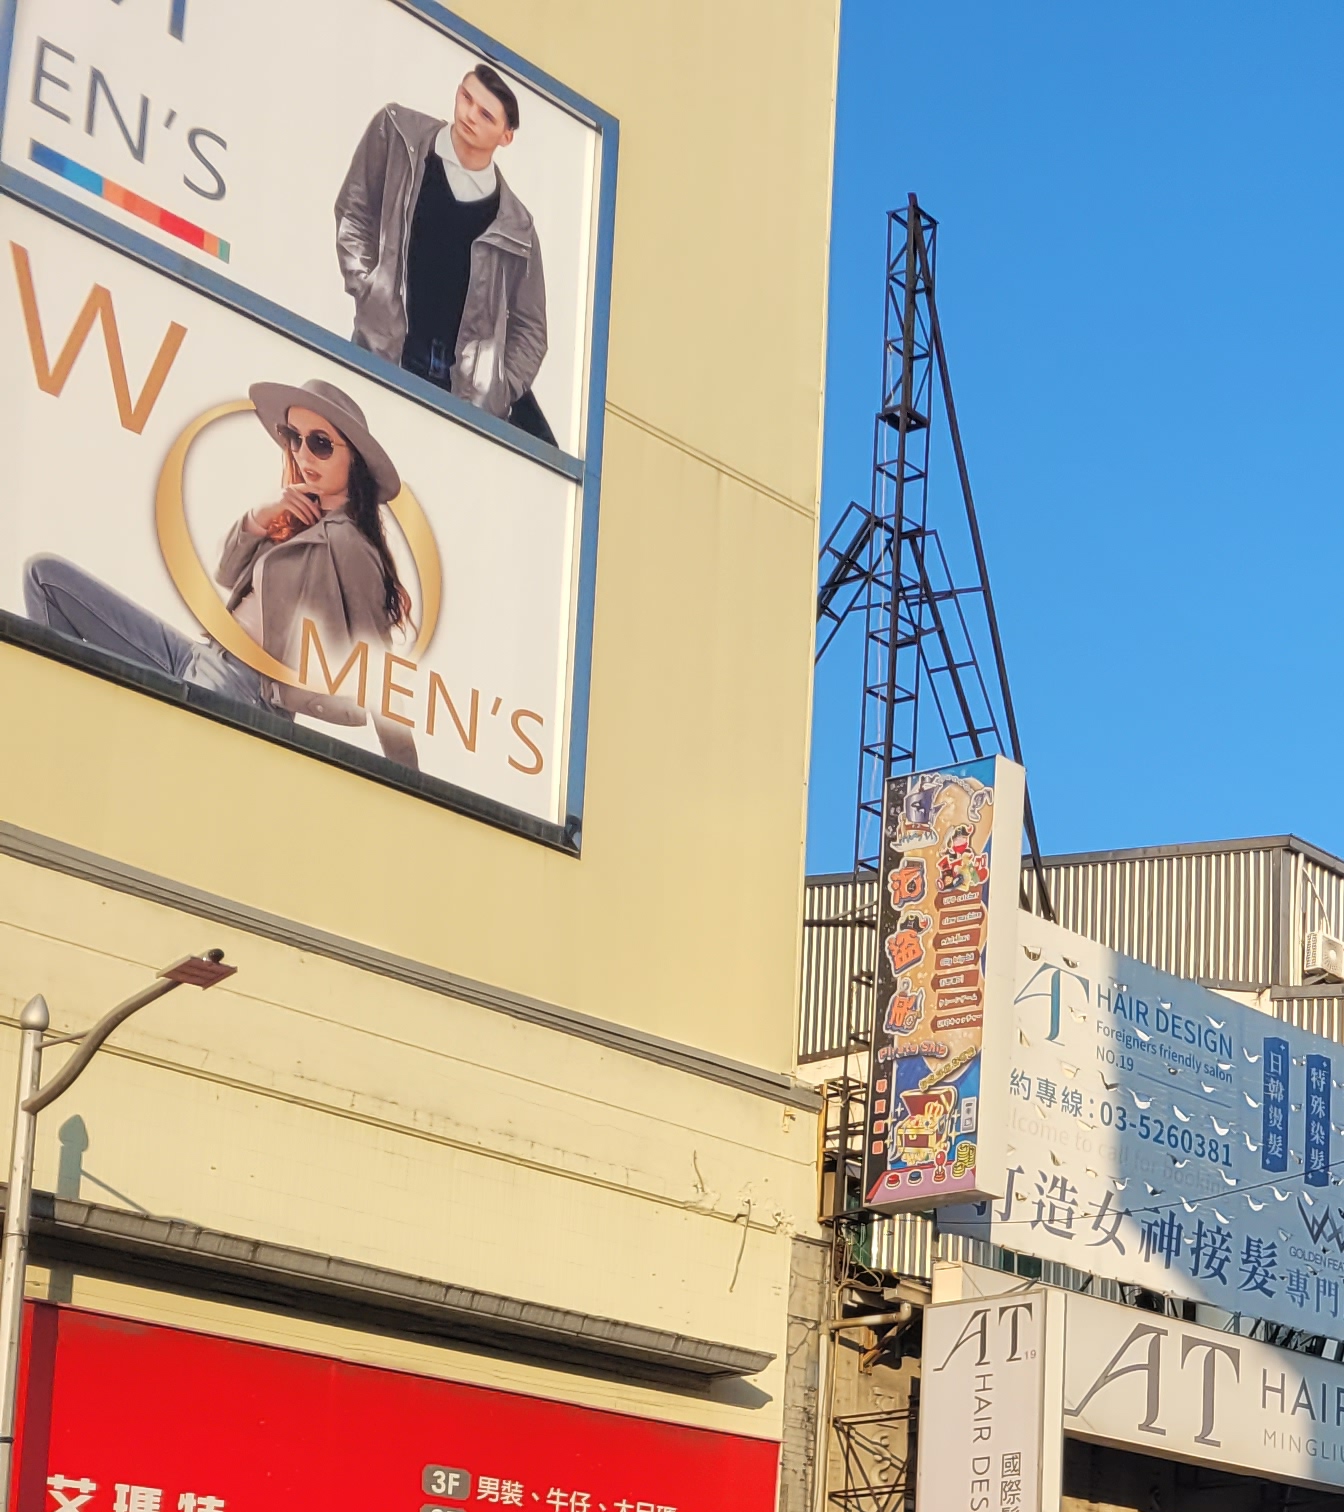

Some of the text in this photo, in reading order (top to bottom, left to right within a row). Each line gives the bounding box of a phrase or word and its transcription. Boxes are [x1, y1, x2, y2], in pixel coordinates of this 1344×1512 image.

[29, 0, 230, 202] EN'S
[1096, 1020, 1233, 1084] Foreigners friendly salon
[1097, 983, 1233, 1060] HAIR DESIGN
[1096, 1045, 1134, 1072] NO.19
[1099, 1101, 1234, 1168] 03-5260381
[1266, 1051, 1285, 1159] 日韓燙髮
[1310, 1066, 1328, 1173] 特殊染髮
[1288, 1246, 1327, 1268] GOLDEN
[933, 1302, 1033, 1372] AT
[1024, 1350, 1037, 1361] 19
[972, 1373, 994, 1444] HAIR
[1063, 1323, 1241, 1449] AT
[431, 1471, 462, 1496] 3F
